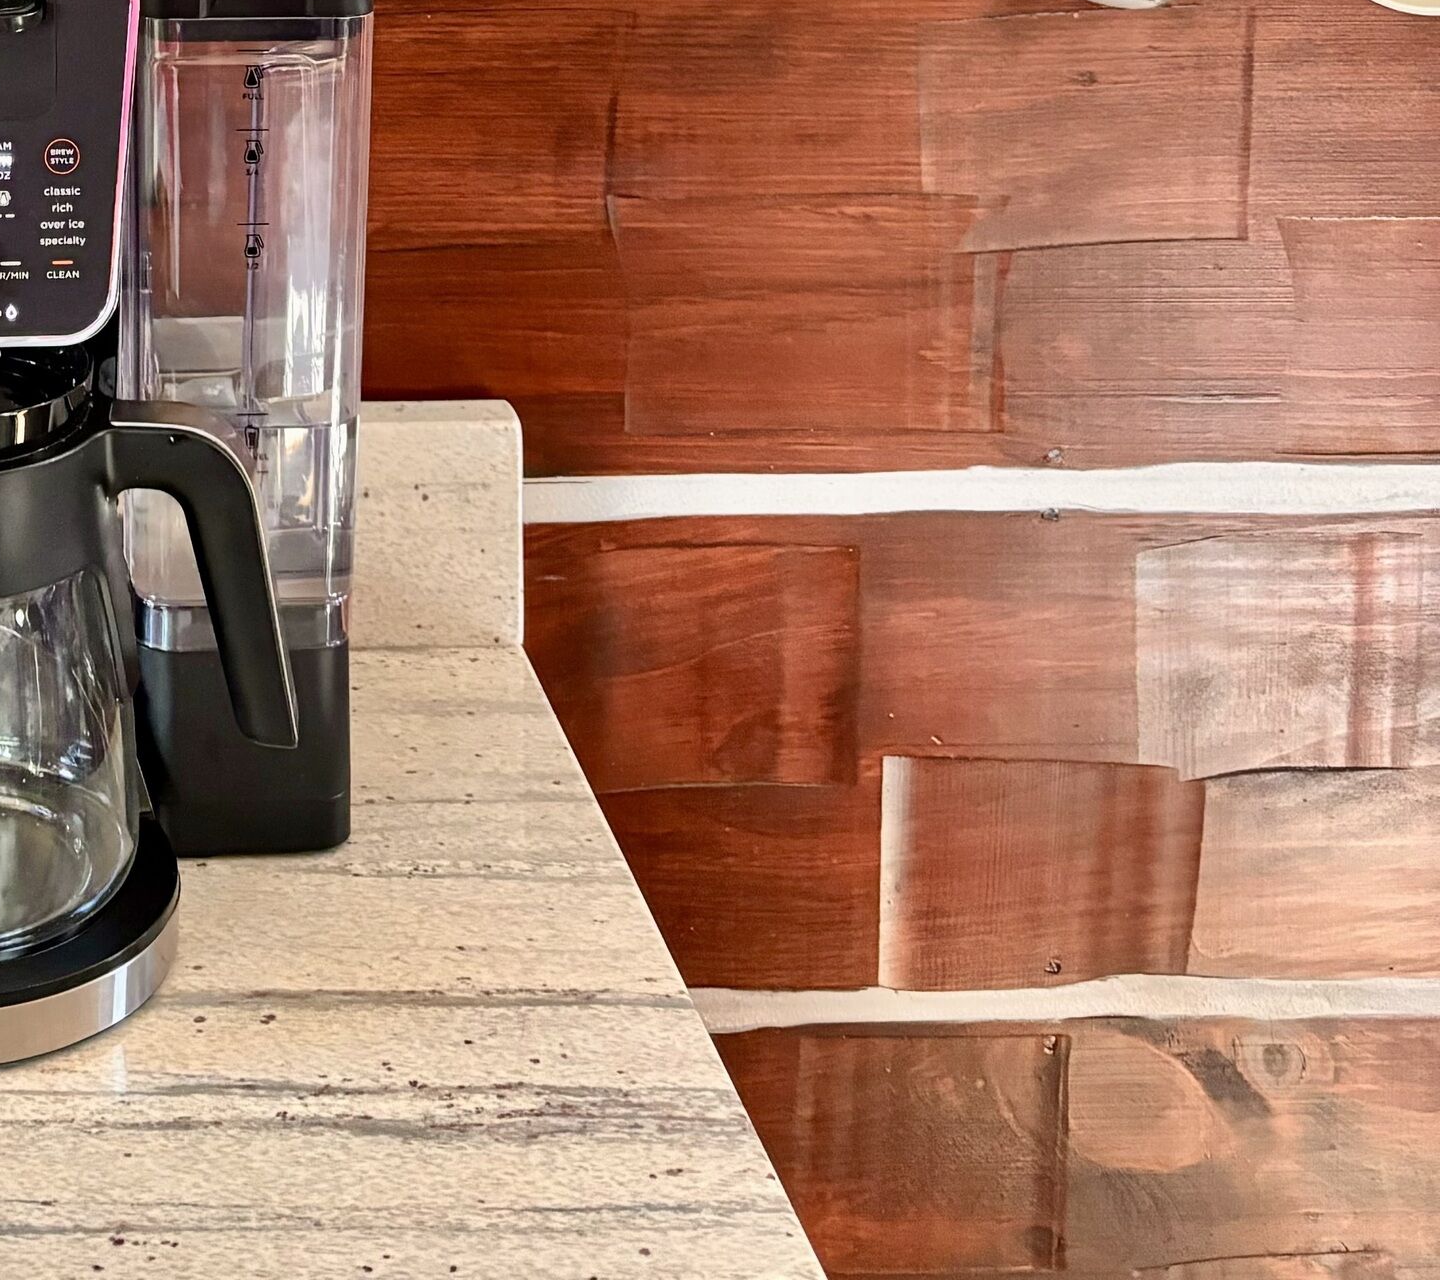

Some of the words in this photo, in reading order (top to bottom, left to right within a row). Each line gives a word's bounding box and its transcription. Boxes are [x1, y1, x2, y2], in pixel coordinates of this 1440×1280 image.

[50, 148, 74, 156] BREW
[50, 157, 74, 165] STYLE
[43, 186, 81, 196] classic
[51, 203, 73, 213] rich
[40, 221, 66, 230] over
[68, 219, 85, 229] ice
[39, 236, 86, 247] specialty
[46, 270, 80, 279] CLEAN
